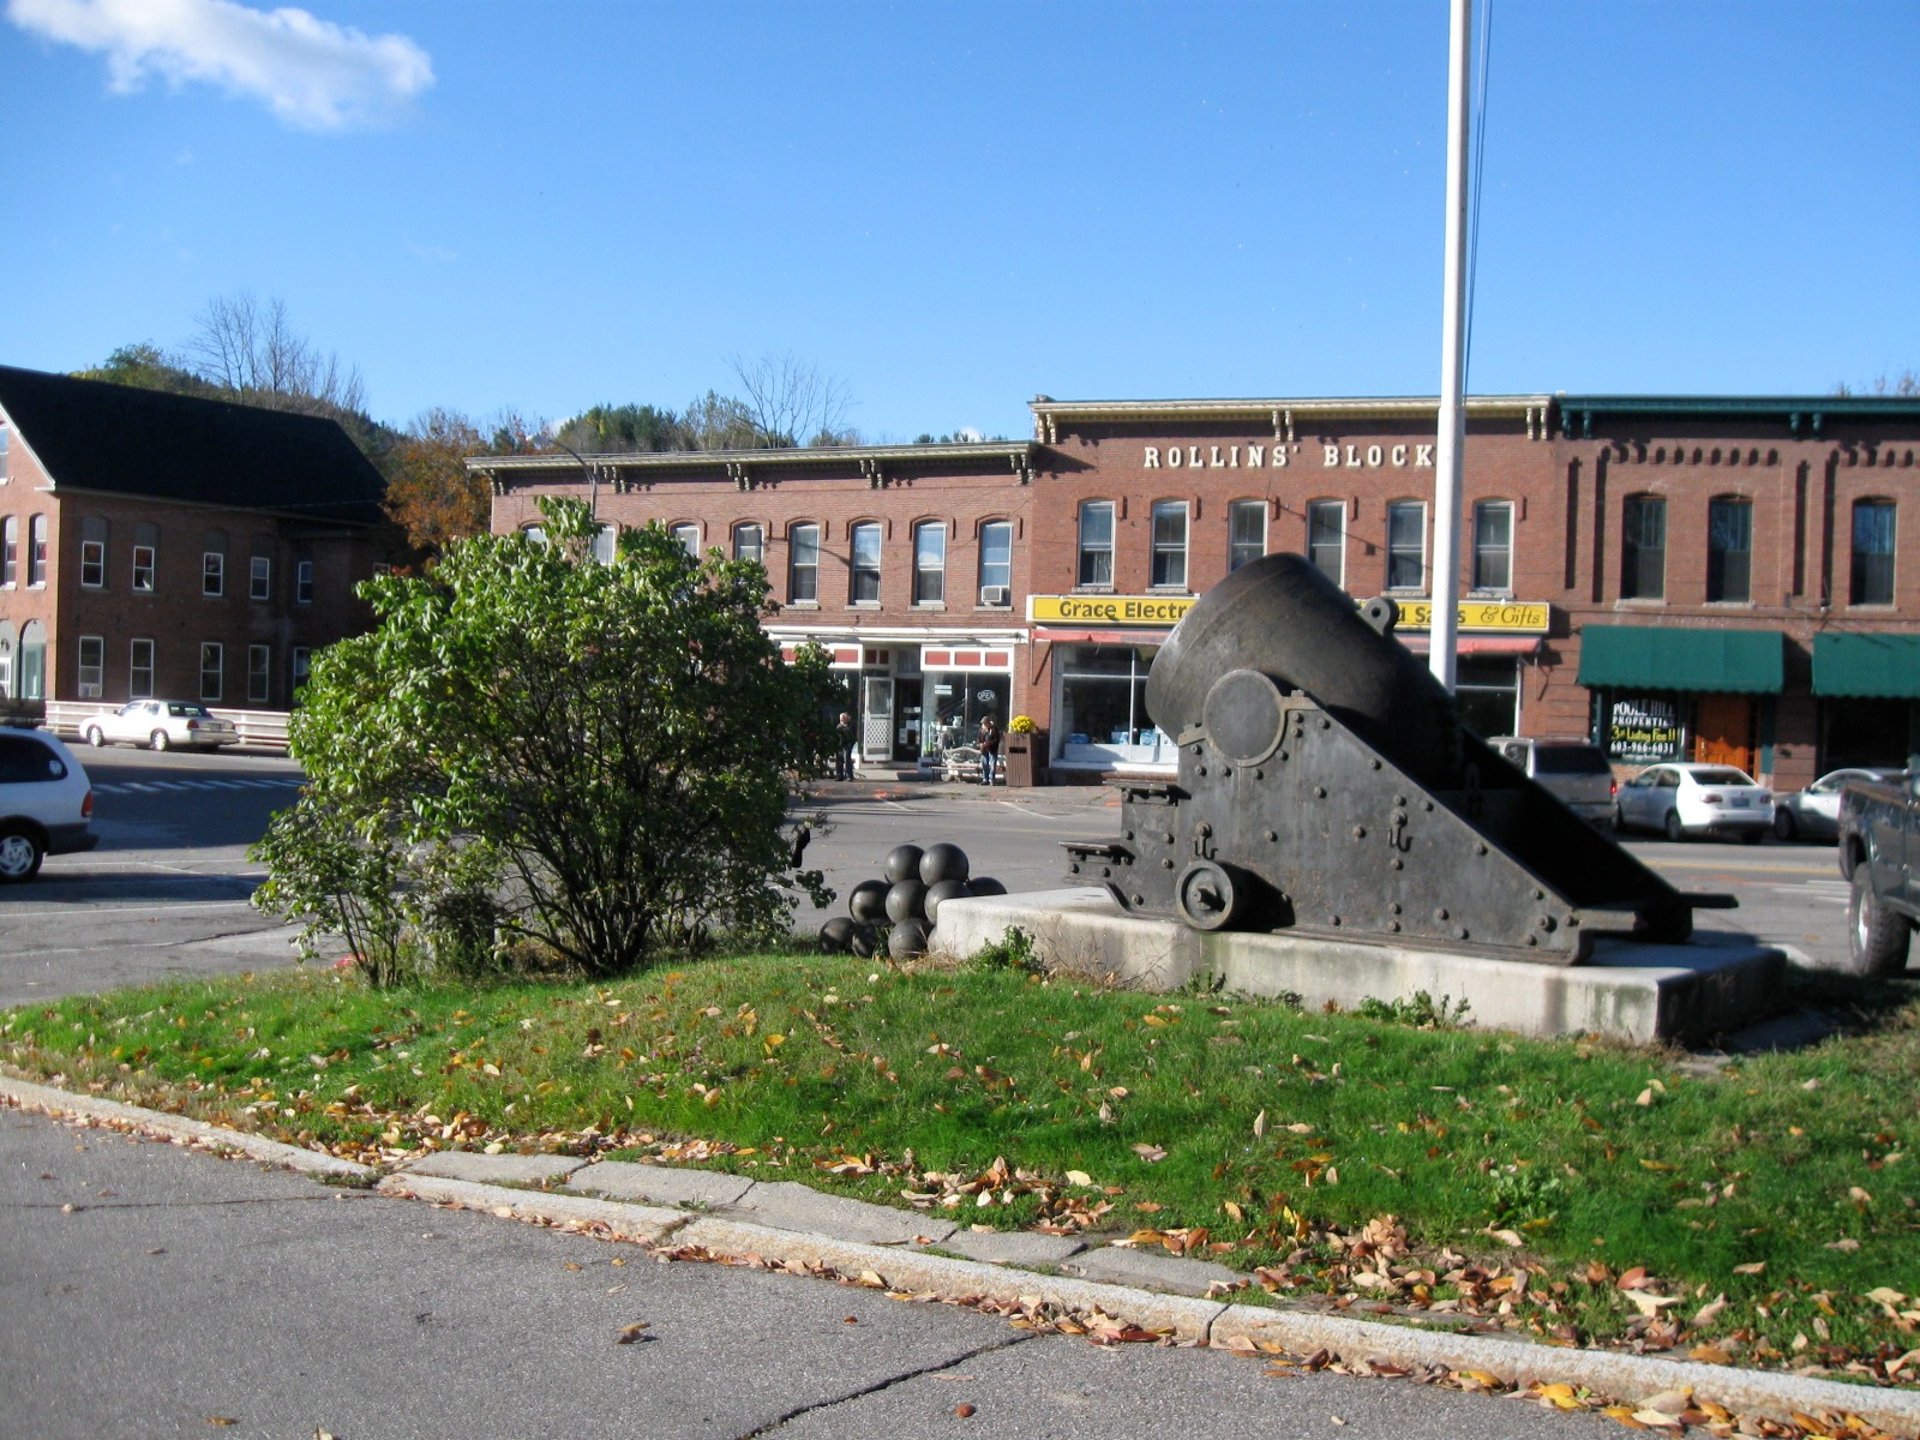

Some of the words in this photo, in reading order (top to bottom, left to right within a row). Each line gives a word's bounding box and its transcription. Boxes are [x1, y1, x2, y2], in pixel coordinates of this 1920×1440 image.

[1144, 445, 1300, 468] ROLLINS'
[1324, 444, 1435, 468] BLOCK
[1059, 600, 1117, 618] Grace
[1125, 602, 1188, 619] Electr
[1501, 605, 1541, 628] Gifts
[978, 690, 995, 701] OPEN
